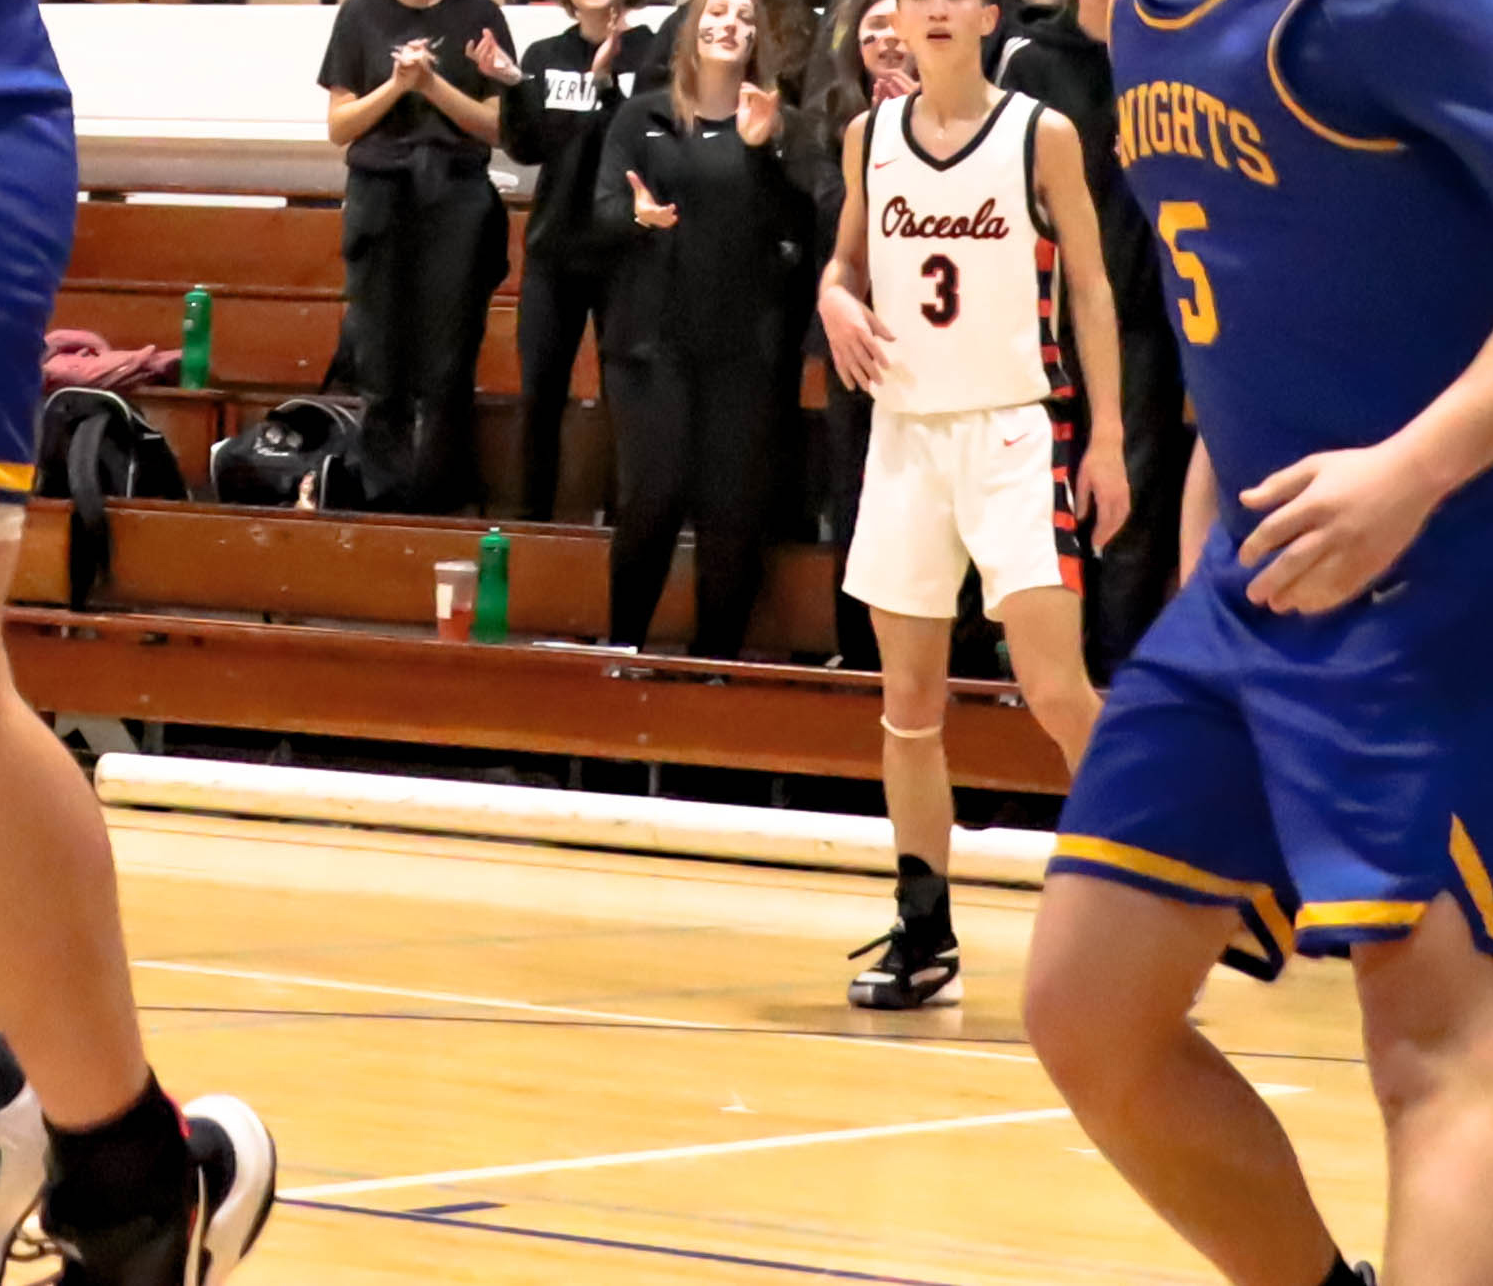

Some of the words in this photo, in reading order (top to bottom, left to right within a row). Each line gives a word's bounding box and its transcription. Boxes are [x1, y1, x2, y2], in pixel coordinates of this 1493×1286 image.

[881, 195, 1010, 240] Osceola
[920, 252, 960, 329] 3
[1157, 200, 1220, 346] 5
